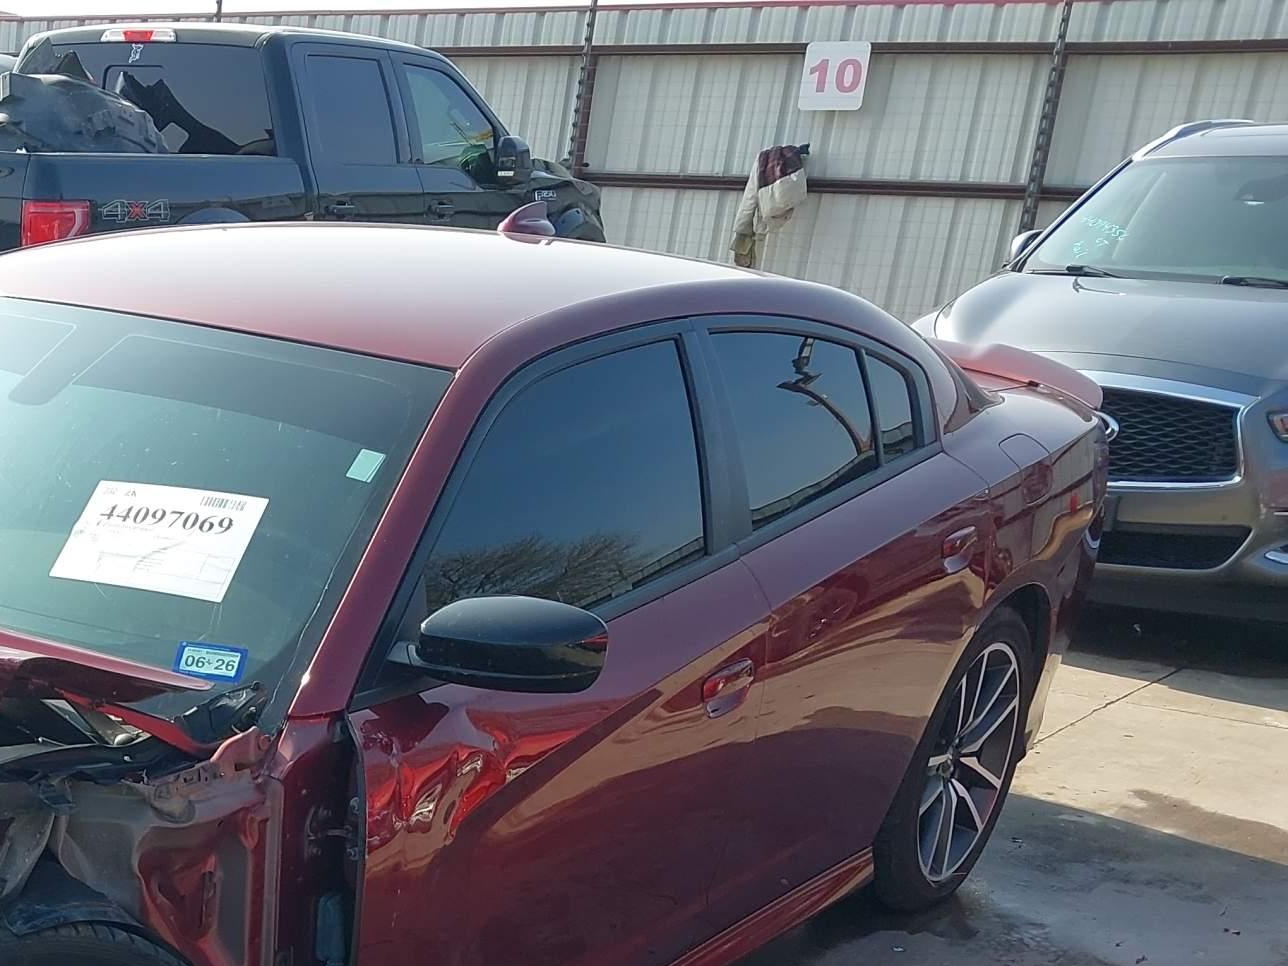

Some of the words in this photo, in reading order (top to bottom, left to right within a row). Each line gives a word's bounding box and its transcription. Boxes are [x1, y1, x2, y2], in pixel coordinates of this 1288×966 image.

[809, 58, 863, 94] 10
[100, 503, 234, 535] 44097069
[184, 654, 206, 669] 06
[214, 658, 236, 672] 26
